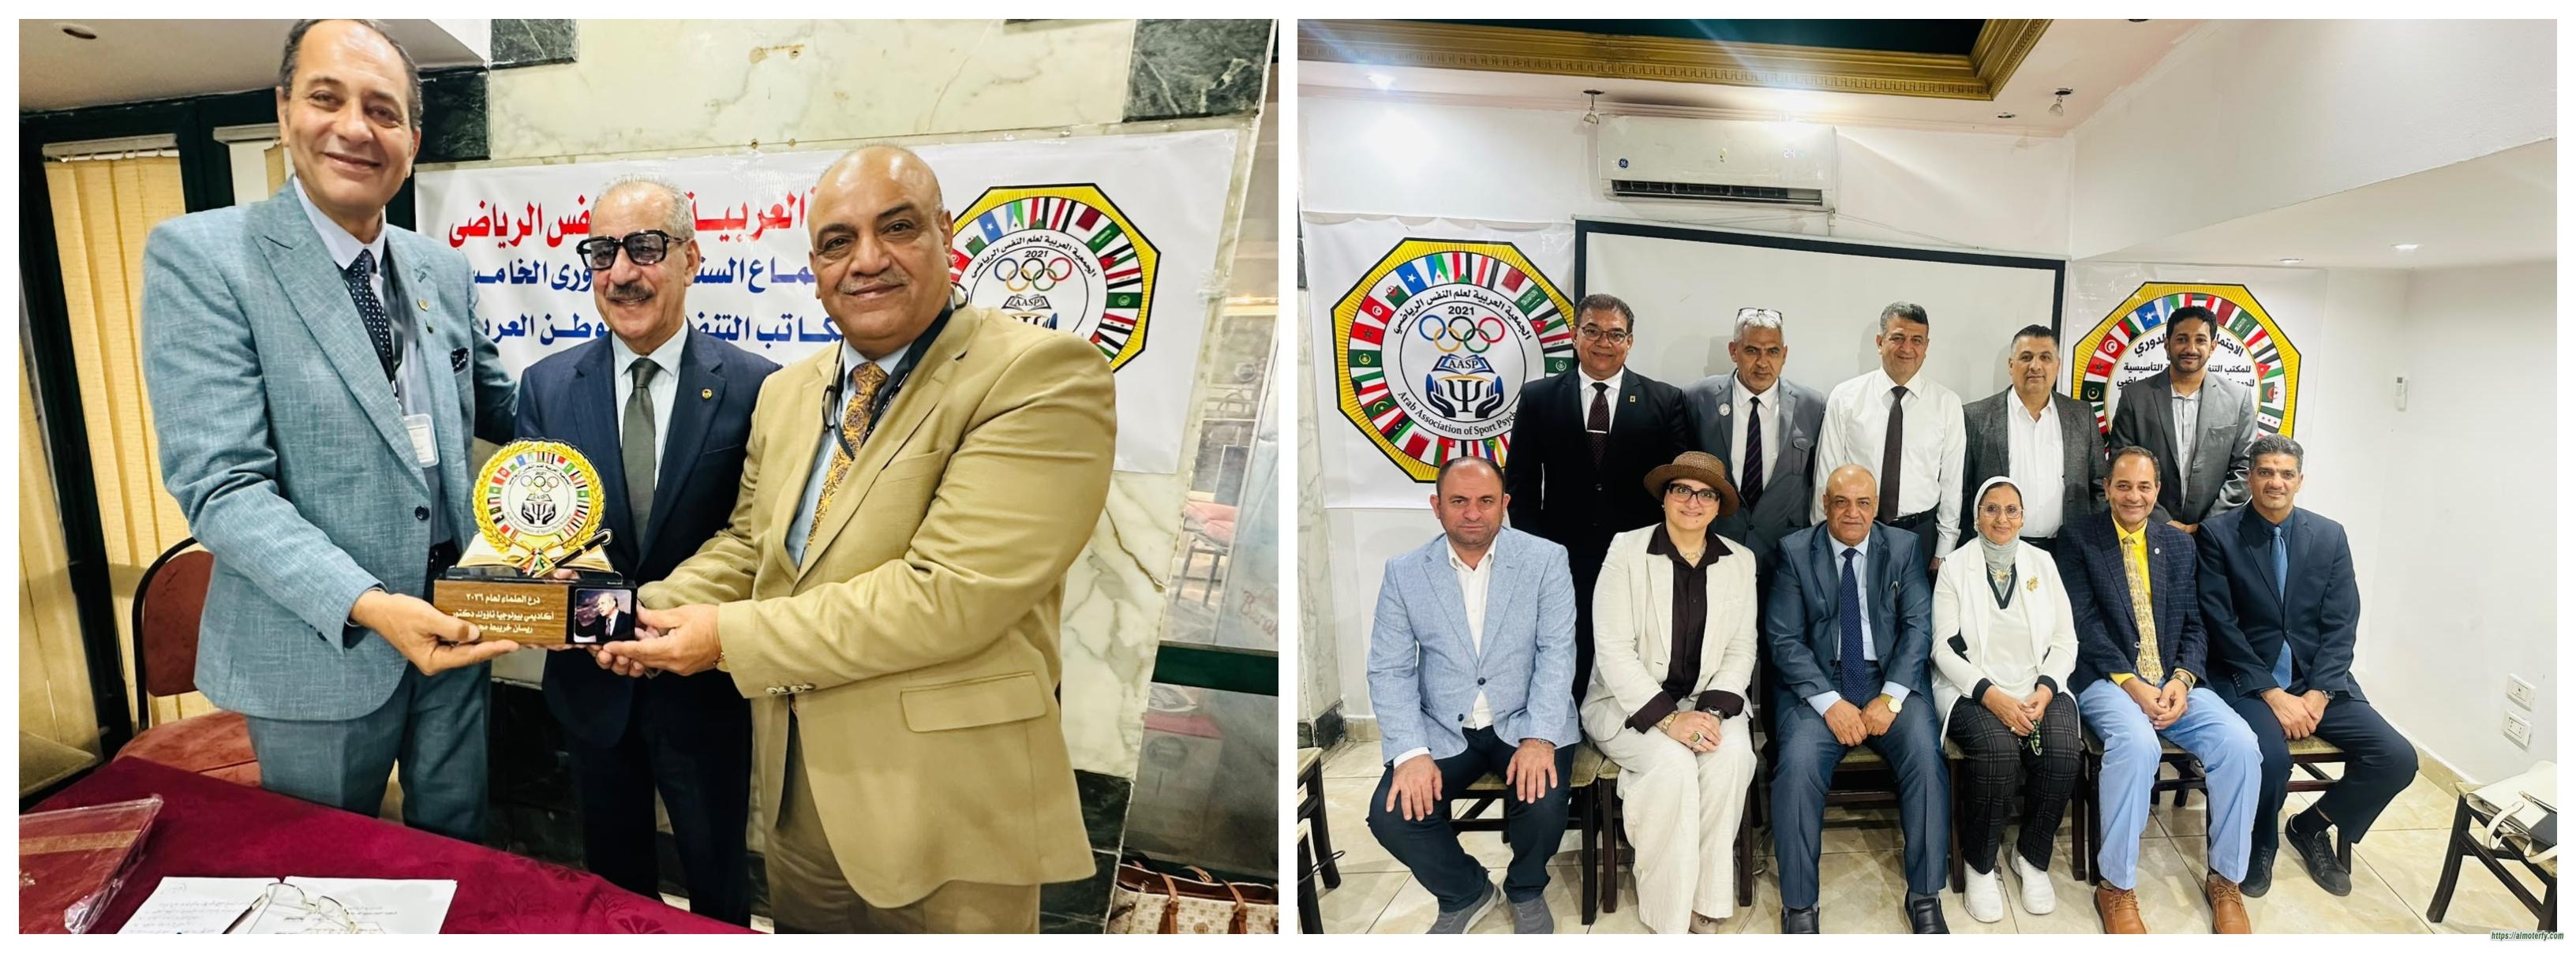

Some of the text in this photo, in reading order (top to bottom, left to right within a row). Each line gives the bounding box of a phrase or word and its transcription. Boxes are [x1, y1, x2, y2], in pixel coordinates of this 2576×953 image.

[1002, 237, 1025, 252] النفس
[1027, 235, 1043, 245] لعلم
[1044, 235, 1072, 251] العربية
[1073, 248, 1097, 277] الجمعية
[1394, 289, 1531, 340] الجمعية العربية لعلم النفس الرياضي
[1448, 306, 1474, 316] 2021
[2217, 334, 2244, 357] الاجتما
[1448, 359, 1478, 369] AASP
[2124, 361, 2163, 373] التأسيسية
[2225, 364, 2251, 376] للمكتب
[1398, 392, 1516, 436] Arab Association of Sport Psych
